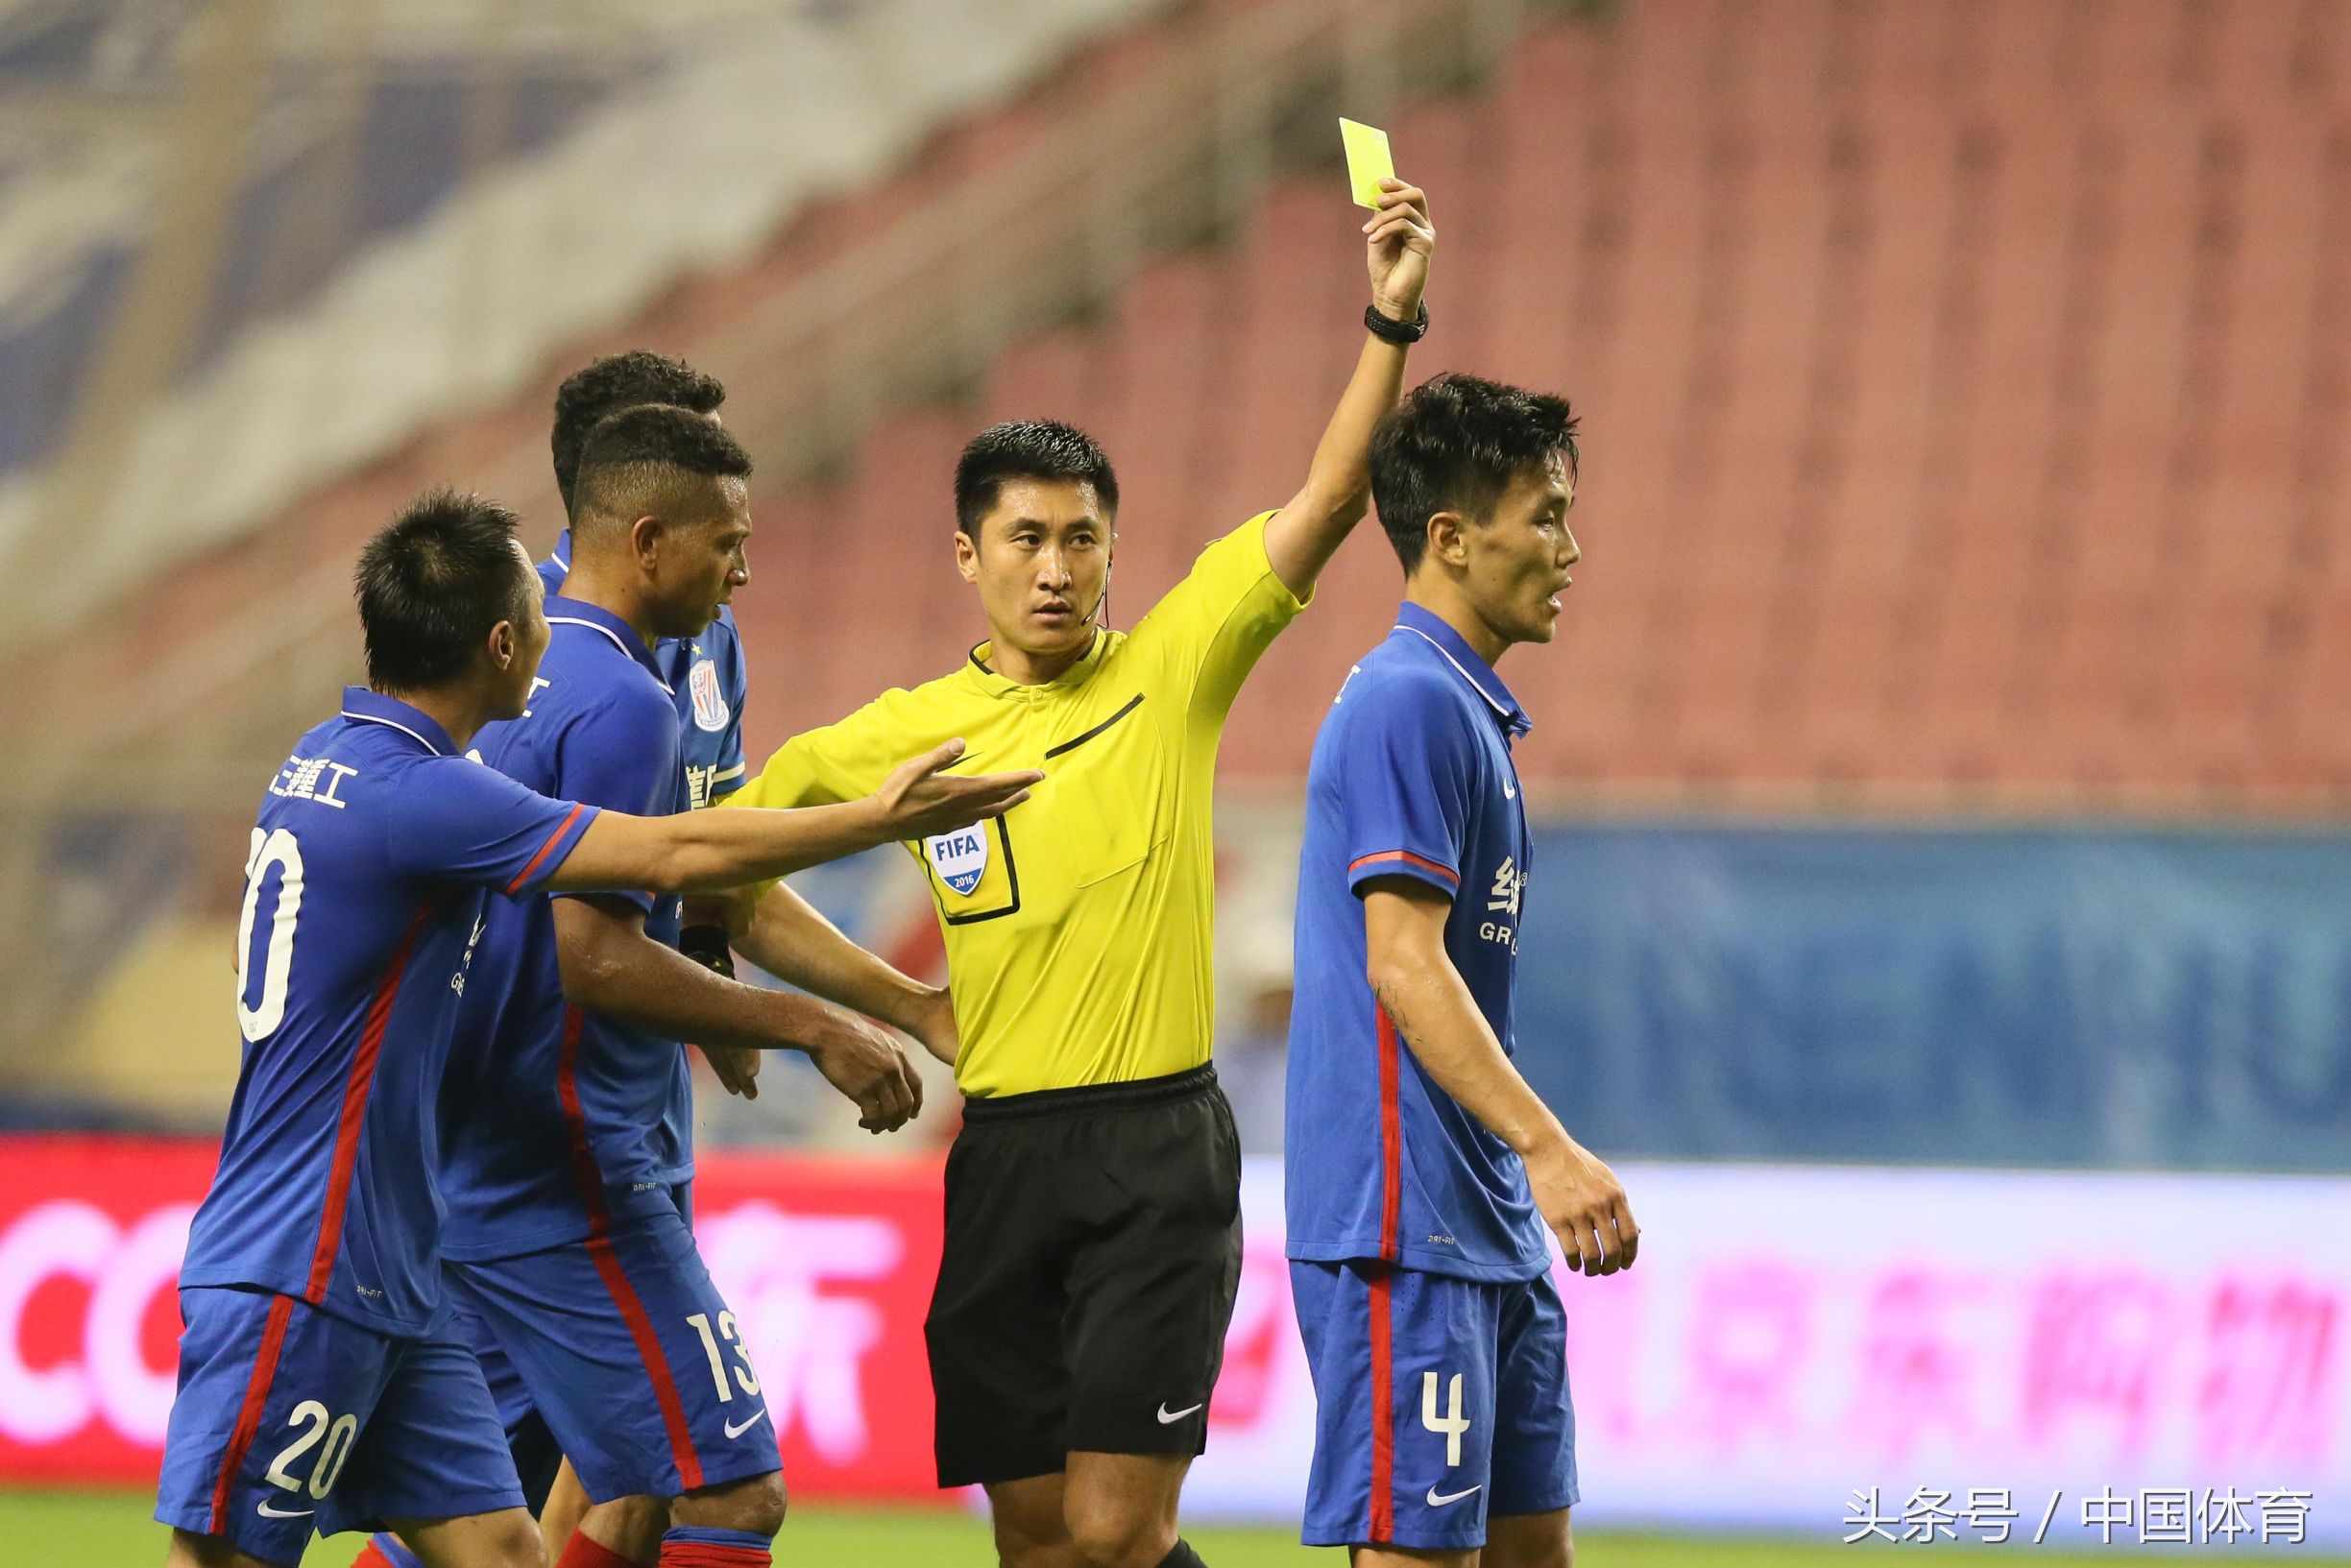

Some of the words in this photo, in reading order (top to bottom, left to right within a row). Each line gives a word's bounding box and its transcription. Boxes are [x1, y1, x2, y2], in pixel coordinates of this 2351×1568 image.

[935, 834, 980, 861] FIFA
[954, 874, 975, 888] 2016
[686, 1310, 762, 1403] 13
[265, 1400, 357, 1500] 20
[1421, 1371, 1470, 1466] 4
